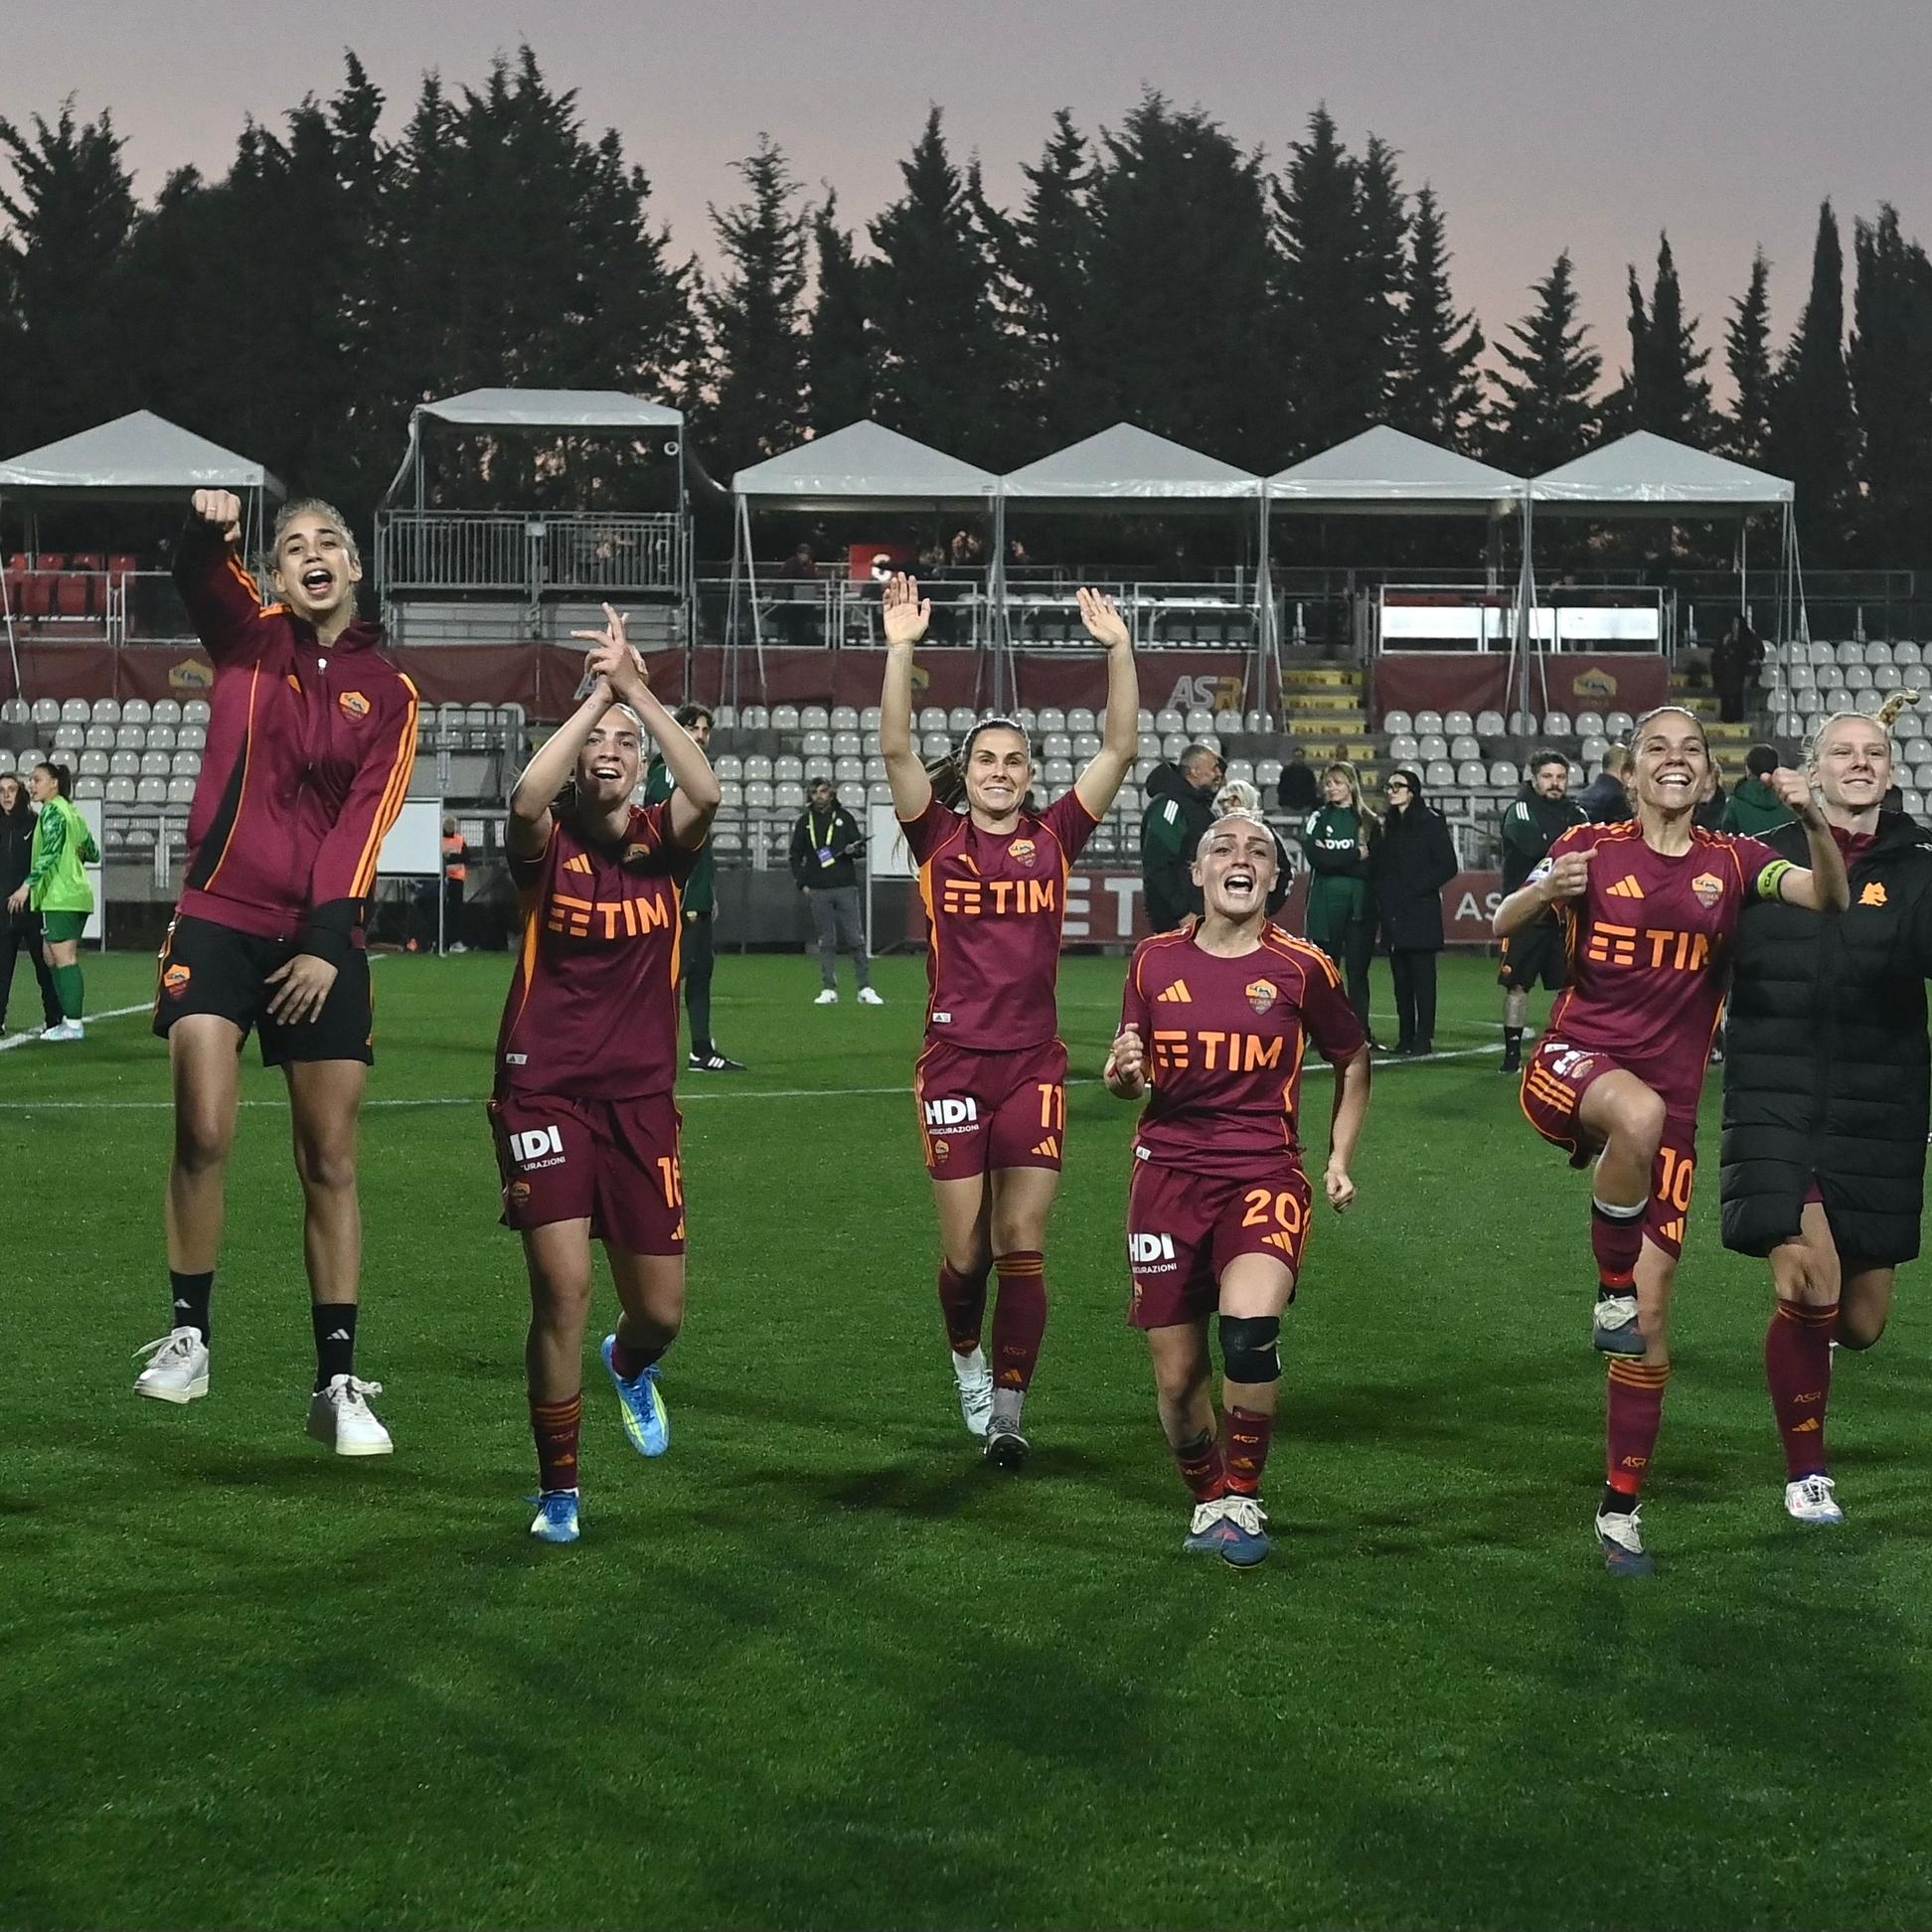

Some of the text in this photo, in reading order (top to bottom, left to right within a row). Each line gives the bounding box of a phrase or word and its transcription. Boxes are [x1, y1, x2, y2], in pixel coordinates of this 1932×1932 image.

[596, 892, 669, 939] TIM
[989, 880, 1054, 914] TIM
[1198, 1031, 1284, 1072] TIM
[924, 1097, 977, 1125] HDI
[1657, 1147, 1693, 1211] 10
[1242, 1189, 1301, 1234] 20
